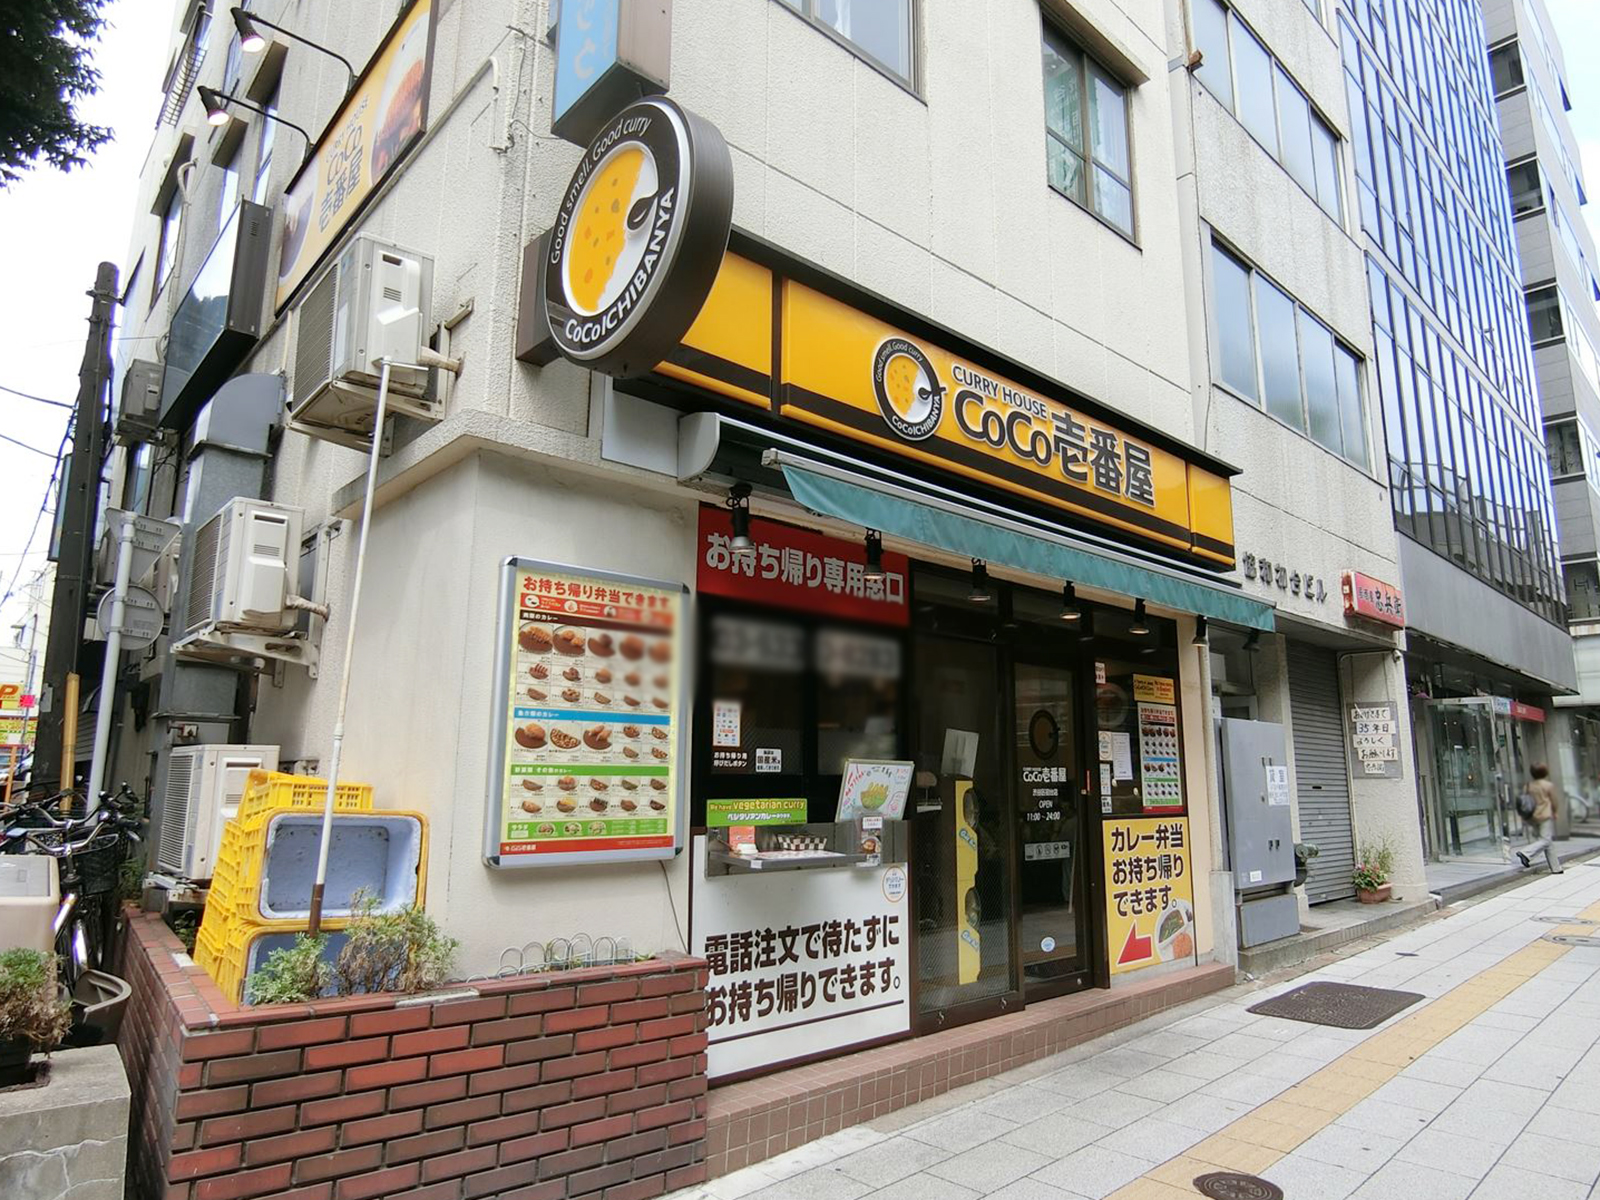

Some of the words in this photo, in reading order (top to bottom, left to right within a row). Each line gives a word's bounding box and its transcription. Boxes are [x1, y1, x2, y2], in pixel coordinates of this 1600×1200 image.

[318, 143, 364, 233] 壱番屋
[551, 214, 568, 265] Good
[566, 160, 594, 210] smell.
[592, 122, 623, 160] Good
[623, 115, 653, 137] curry
[565, 186, 675, 343] CoCoICHIBANYA
[875, 358, 884, 383] Good
[892, 341, 908, 352] Good
[908, 347, 924, 362] curry
[952, 364, 1000, 398] CURRY
[1001, 386, 1048, 418] HOUSE
[891, 394, 941, 436] CoCoICHIBANYA
[954, 389, 1155, 508] CoCo壱番屋
[523, 576, 671, 609] お持ち帰り弁当できます
[1356, 737, 1385, 746] よろしく
[733, 799, 782, 811] vegetarian
[784, 799, 805, 810] curry
[1038, 800, 1053, 808] OPEN
[1111, 823, 1184, 852] カレー弁当
[1112, 854, 1184, 885] お持ち帰り
[1113, 885, 1177, 917] できます。
[704, 915, 900, 976] 電話注文で待たずに
[706, 957, 901, 1027] お持ち帰りできます。
